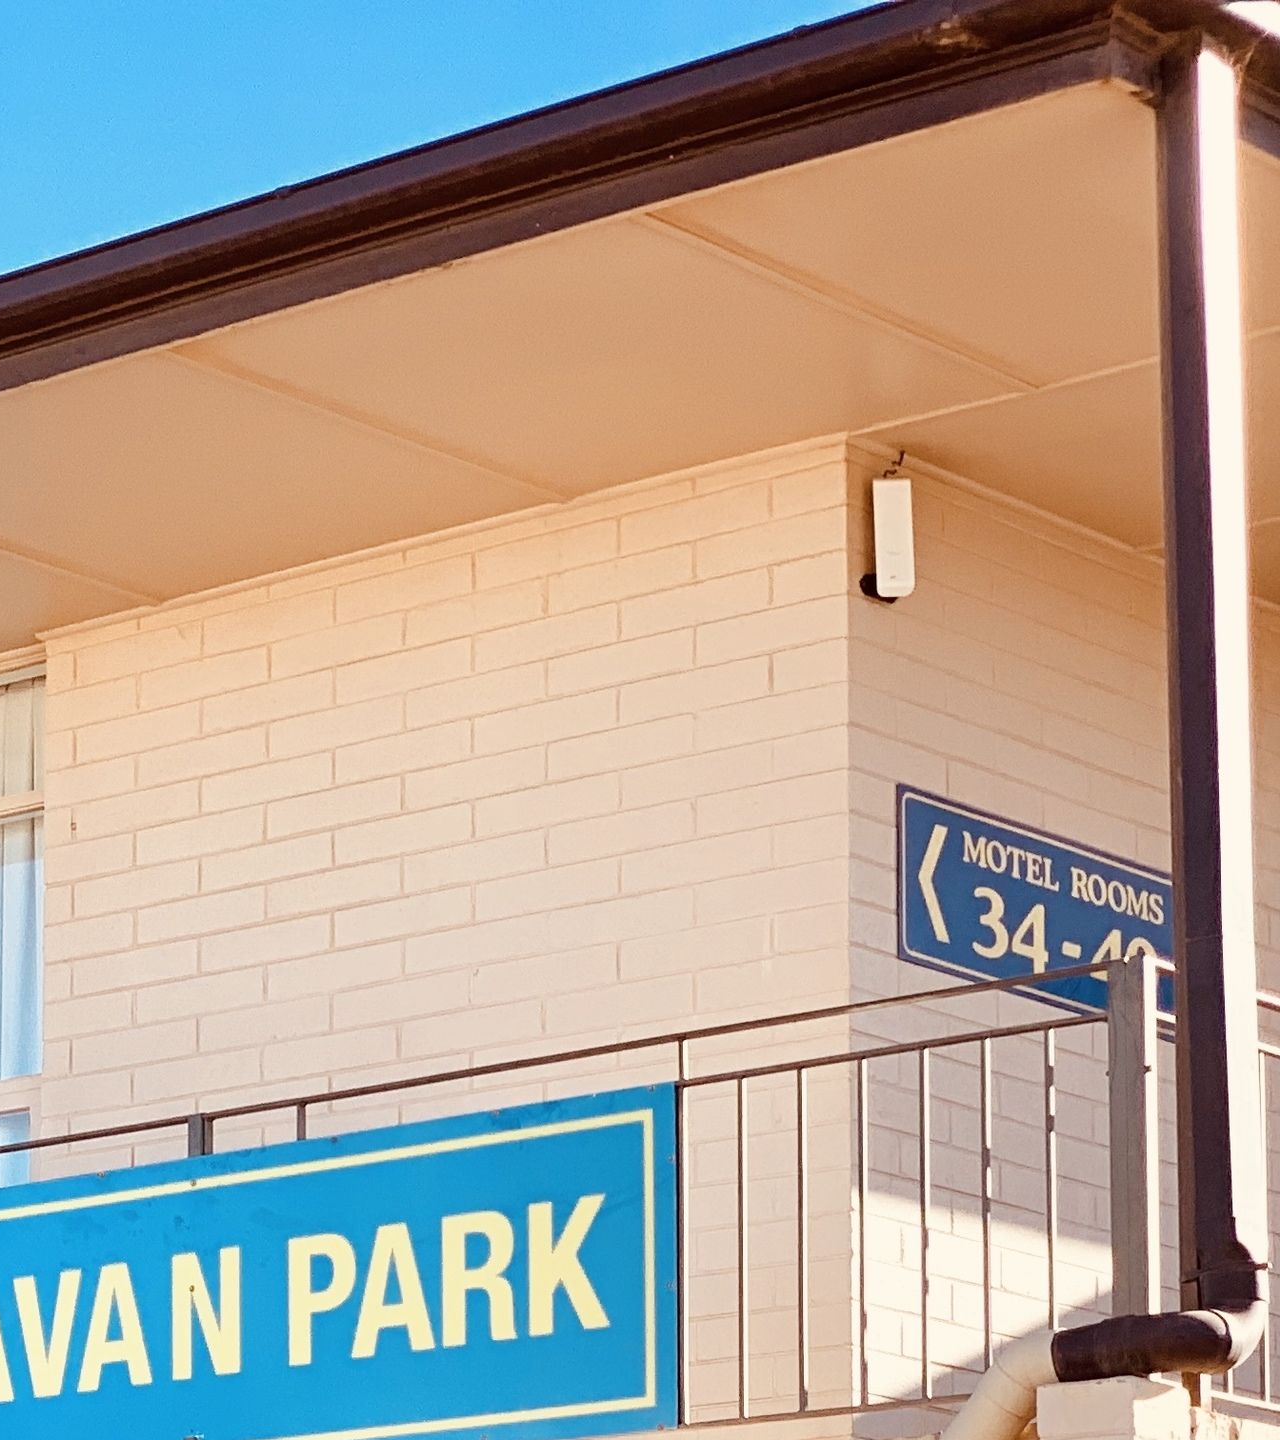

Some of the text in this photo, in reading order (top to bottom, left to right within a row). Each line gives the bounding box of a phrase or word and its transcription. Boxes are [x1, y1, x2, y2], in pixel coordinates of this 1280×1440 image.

[962, 831, 1165, 926] MOTEL ROOMS
[286, 1193, 611, 1368] PARK
